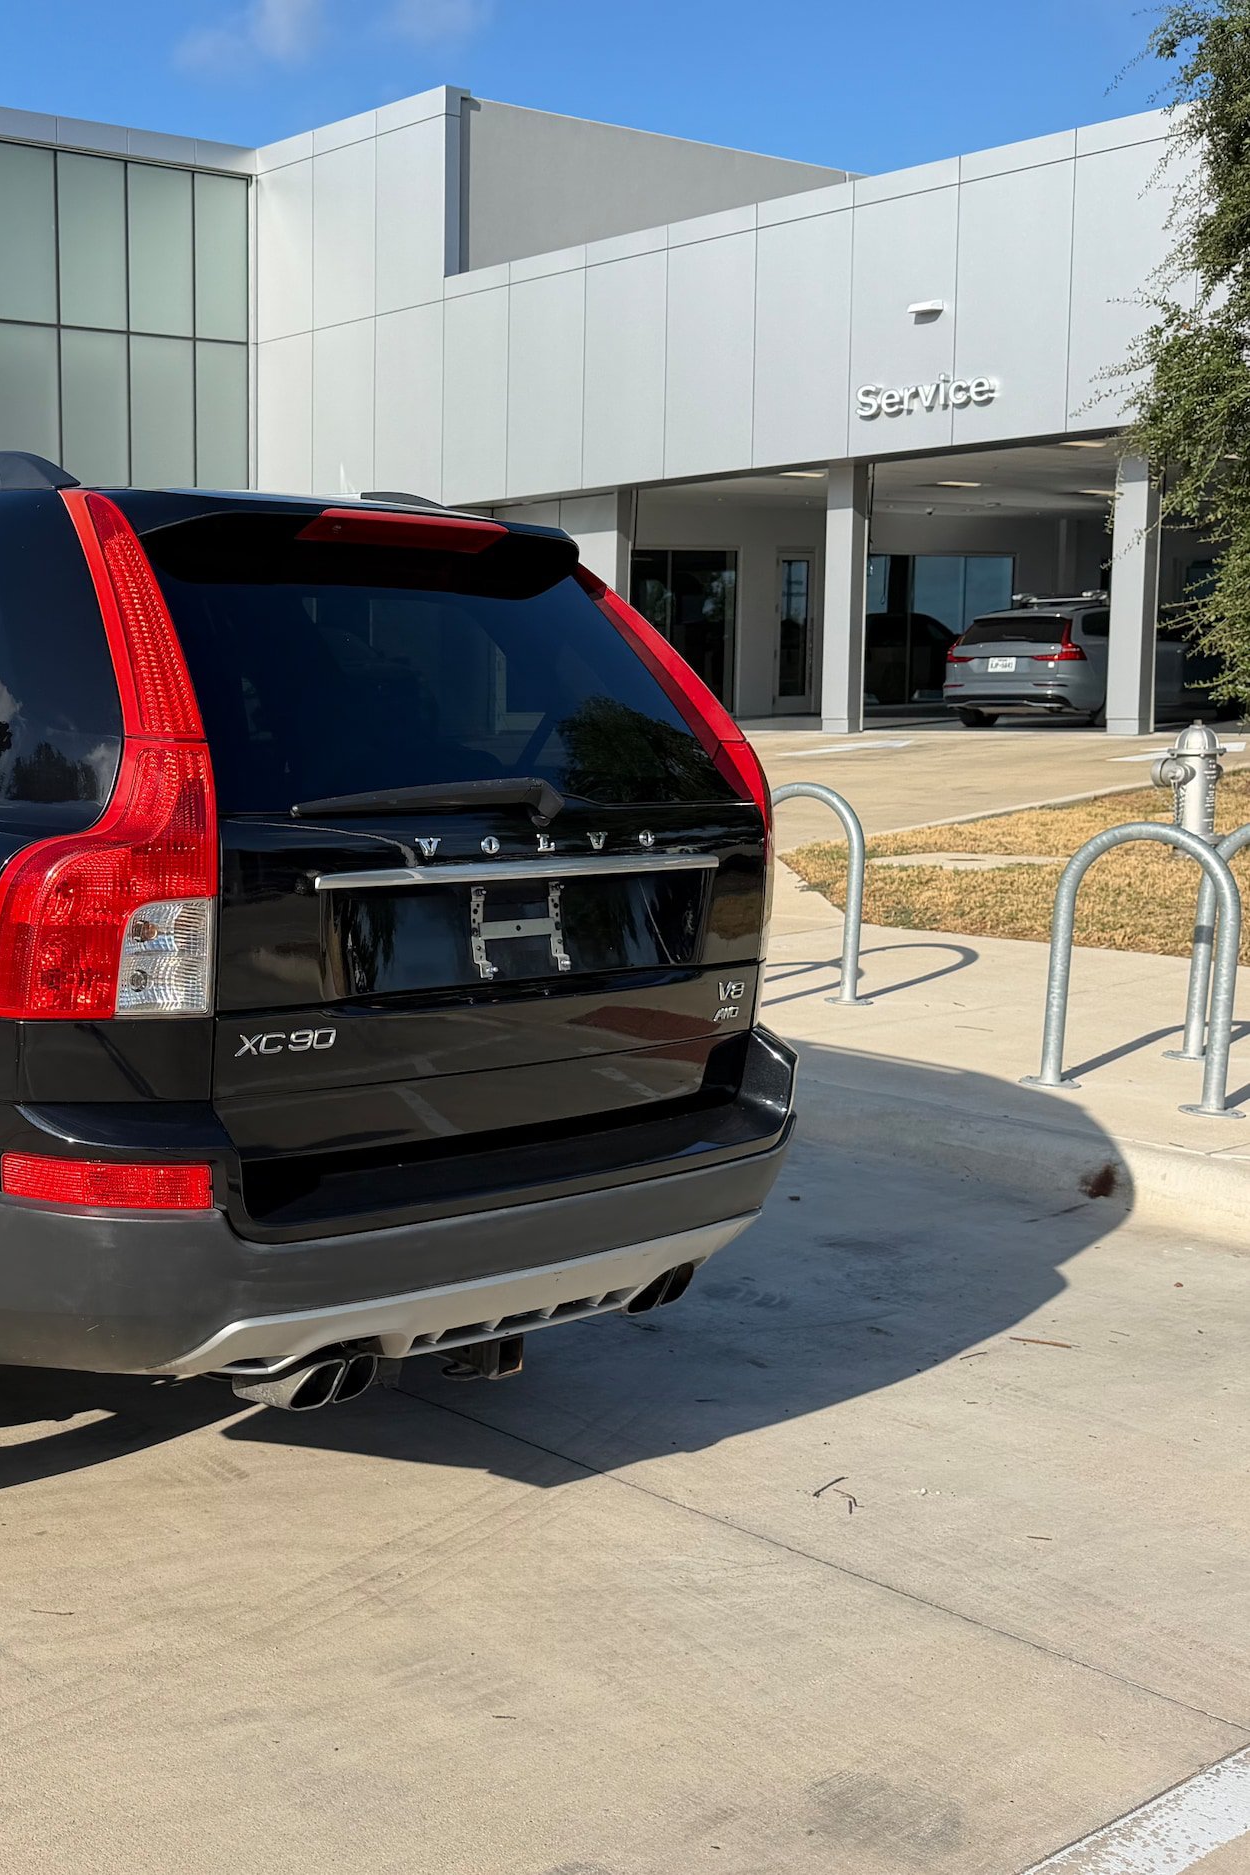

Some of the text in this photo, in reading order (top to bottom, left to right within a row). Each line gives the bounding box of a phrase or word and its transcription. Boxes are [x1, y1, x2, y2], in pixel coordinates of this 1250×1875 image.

[855, 373, 992, 417] Service
[414, 829, 656, 857] VOLVO
[718, 981, 745, 1001] V8
[234, 1027, 337, 1057] XC90
